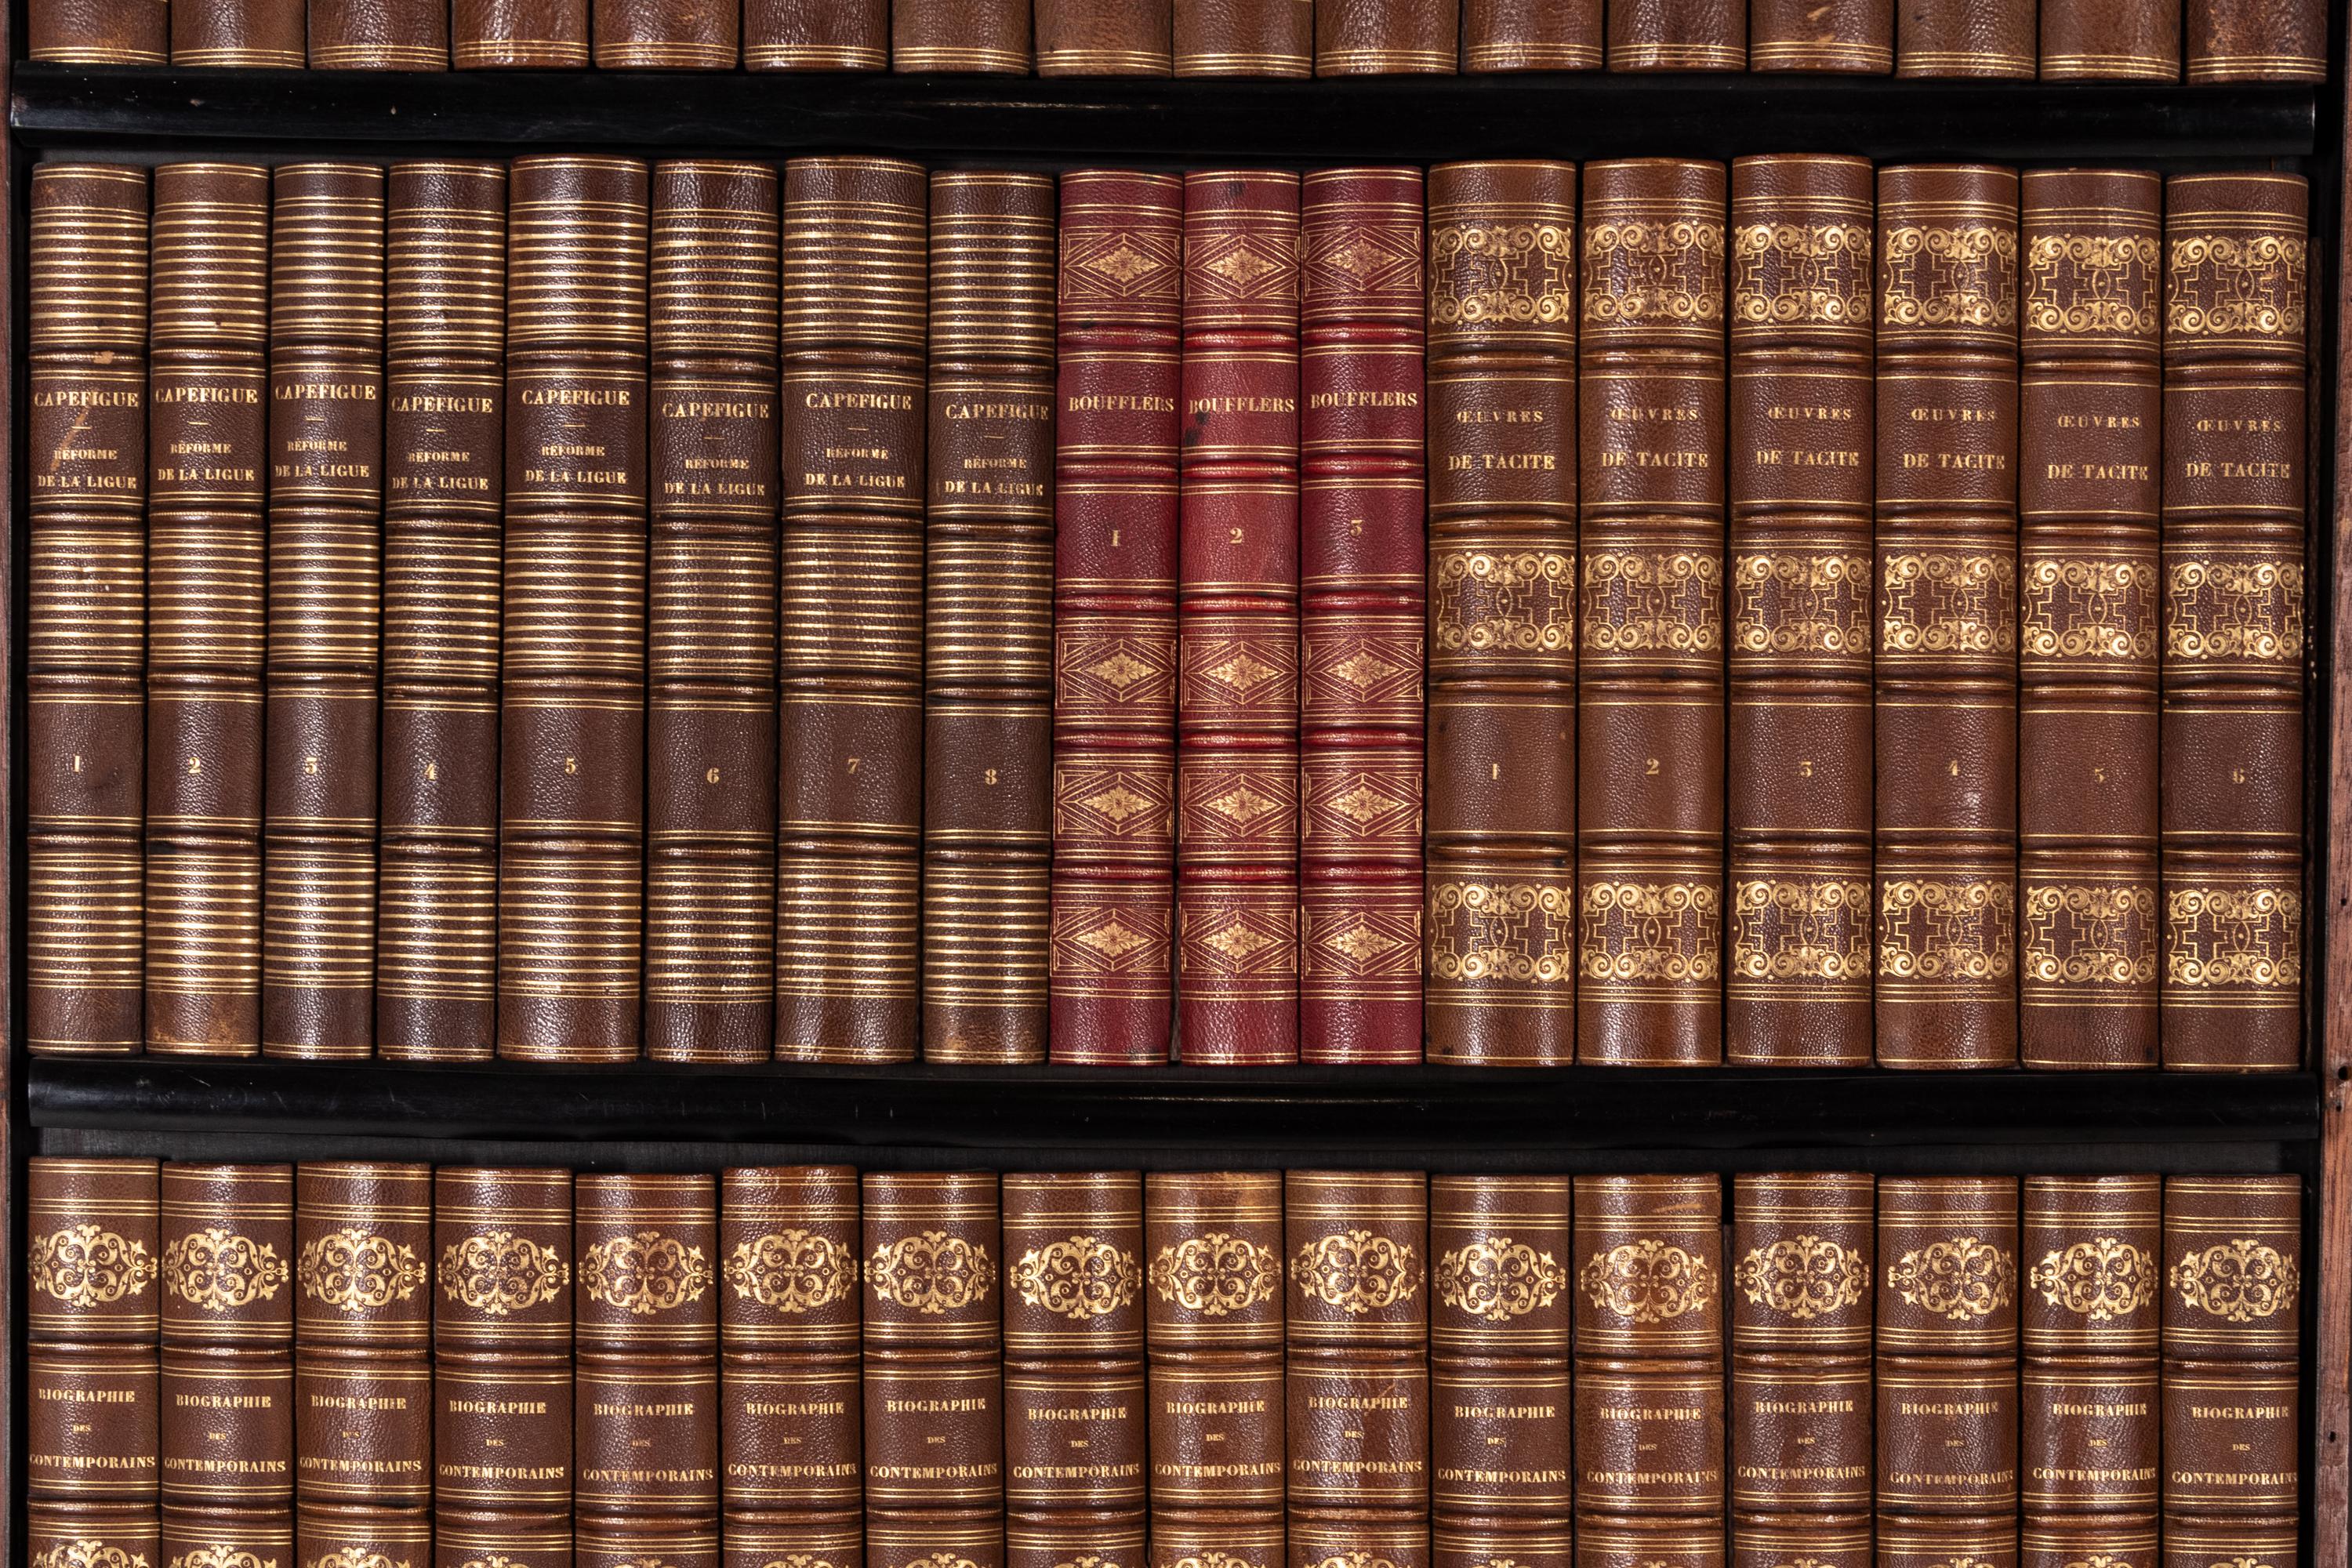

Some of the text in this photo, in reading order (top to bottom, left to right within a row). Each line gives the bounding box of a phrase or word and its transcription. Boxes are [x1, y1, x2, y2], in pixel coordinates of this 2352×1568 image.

[34, 391, 138, 407] CAPEFIGUE
[156, 387, 258, 404] CAPEFIGUE
[275, 384, 376, 400] CAPEFIGUE
[522, 390, 630, 406] CAPEFIGUE
[392, 397, 492, 413] CAPEFIGUE
[806, 393, 911, 410] CAPEFIGUE
[1069, 395, 1174, 412] BOUFFLERS
[1189, 397, 1294, 414] BOUFFLERS
[1311, 392, 1417, 408] BOUFFLERS
[662, 402, 769, 419] CAPEFIGUE
[946, 404, 1048, 419] CAPEFIGUE
[1449, 455, 1555, 470] DE TACITE
[1602, 452, 1708, 468] DE TACITE
[1756, 451, 1859, 467] DE TACITE
[1904, 454, 2005, 470] DE TACITE
[158, 469, 255, 481] DE LA LIGUE
[275, 465, 369, 477] DE LA LIGUE
[525, 470, 627, 484] DE LA LIGUE
[2047, 464, 2148, 481] DE TACITE
[2187, 463, 2290, 478] DE TACITE
[38, 475, 136, 488] DE LA LIGUE
[392, 477, 488, 490] DE LA LIGUE
[805, 474, 905, 488] DE LA LIGUE
[945, 481, 1043, 495] DE LA LIGUE
[665, 483, 764, 495] DE LA LIGUE
[1350, 519, 1363, 536] 3
[1111, 529, 1119, 546] 1
[1229, 528, 1242, 544] 2
[72, 756, 80, 772] 1
[188, 757, 201, 774] 2
[564, 757, 575, 774] 5
[848, 758, 860, 775] 7
[1492, 764, 1497, 779] 1
[1646, 759, 1659, 775] 2
[1947, 760, 1961, 776] 4
[424, 764, 435, 781] 4
[706, 768, 720, 784] 6
[985, 769, 997, 785] 8
[2094, 768, 2104, 784] 5
[2232, 768, 2245, 784] 6
[39, 1388, 135, 1403] BIOGRAPHIE
[176, 1394, 271, 1409] BIOGRAPHIE
[311, 1395, 406, 1410] BIOGRAPHIE
[1308, 1396, 1407, 1409] BIOGRAPHIE
[449, 1400, 546, 1414] BIOGRAPHIE
[593, 1403, 693, 1417] BIOGRAPHIE
[746, 1401, 844, 1416] BIOGRAPHIE
[887, 1399, 985, 1412] BIOGRAPHIE
[1166, 1400, 1265, 1414] BIOGRAPHIE
[1454, 1406, 1555, 1419] BIOGRAPHIE
[1755, 1400, 1853, 1413] BIOGRAPHIE
[1901, 1401, 1998, 1415] BIOGRAPHIE
[2053, 1403, 2146, 1416] BIOGRAPHIE
[2192, 1406, 2289, 1419] BIOGRAPHIE
[1029, 1406, 1127, 1421] BIOGRAPHIE
[1600, 1407, 1700, 1421] BIOGRAPHIE
[73, 1424, 91, 1432] DES
[1345, 1430, 1360, 1439] DES
[209, 1432, 227, 1440] DES
[632, 1439, 651, 1447] DES
[1070, 1439, 1089, 1448] DES
[1206, 1433, 1225, 1442] DES
[30, 1454, 155, 1469] CONTEMPORAINS
[165, 1457, 286, 1472] CONTEMPORAINS
[300, 1457, 421, 1473] CONTEMPORAINS
[1155, 1461, 1280, 1477] CONTEMPORAINS
[1293, 1460, 1422, 1473] CONTEMPORAINS
[439, 1465, 564, 1480] CONTEMPORAINS
[583, 1468, 713, 1483] CONTEMPORAINS
[728, 1462, 856, 1477] CONTEMPORAINS
[870, 1463, 997, 1479] CONTEMPORAINS
[1014, 1464, 1139, 1479] CONTEMPORAINS
[1439, 1468, 1566, 1483] CONTEMPORAINS
[1588, 1470, 1717, 1484] CONTEMPORAINS
[1738, 1465, 1865, 1481] CONTEMPORAINS
[2033, 1467, 2155, 1481] CONTEMPORAINS
[1890, 1470, 2013, 1485] CONTEMPORAINS
[2172, 1471, 2297, 1486] CONTEMPORAINS
